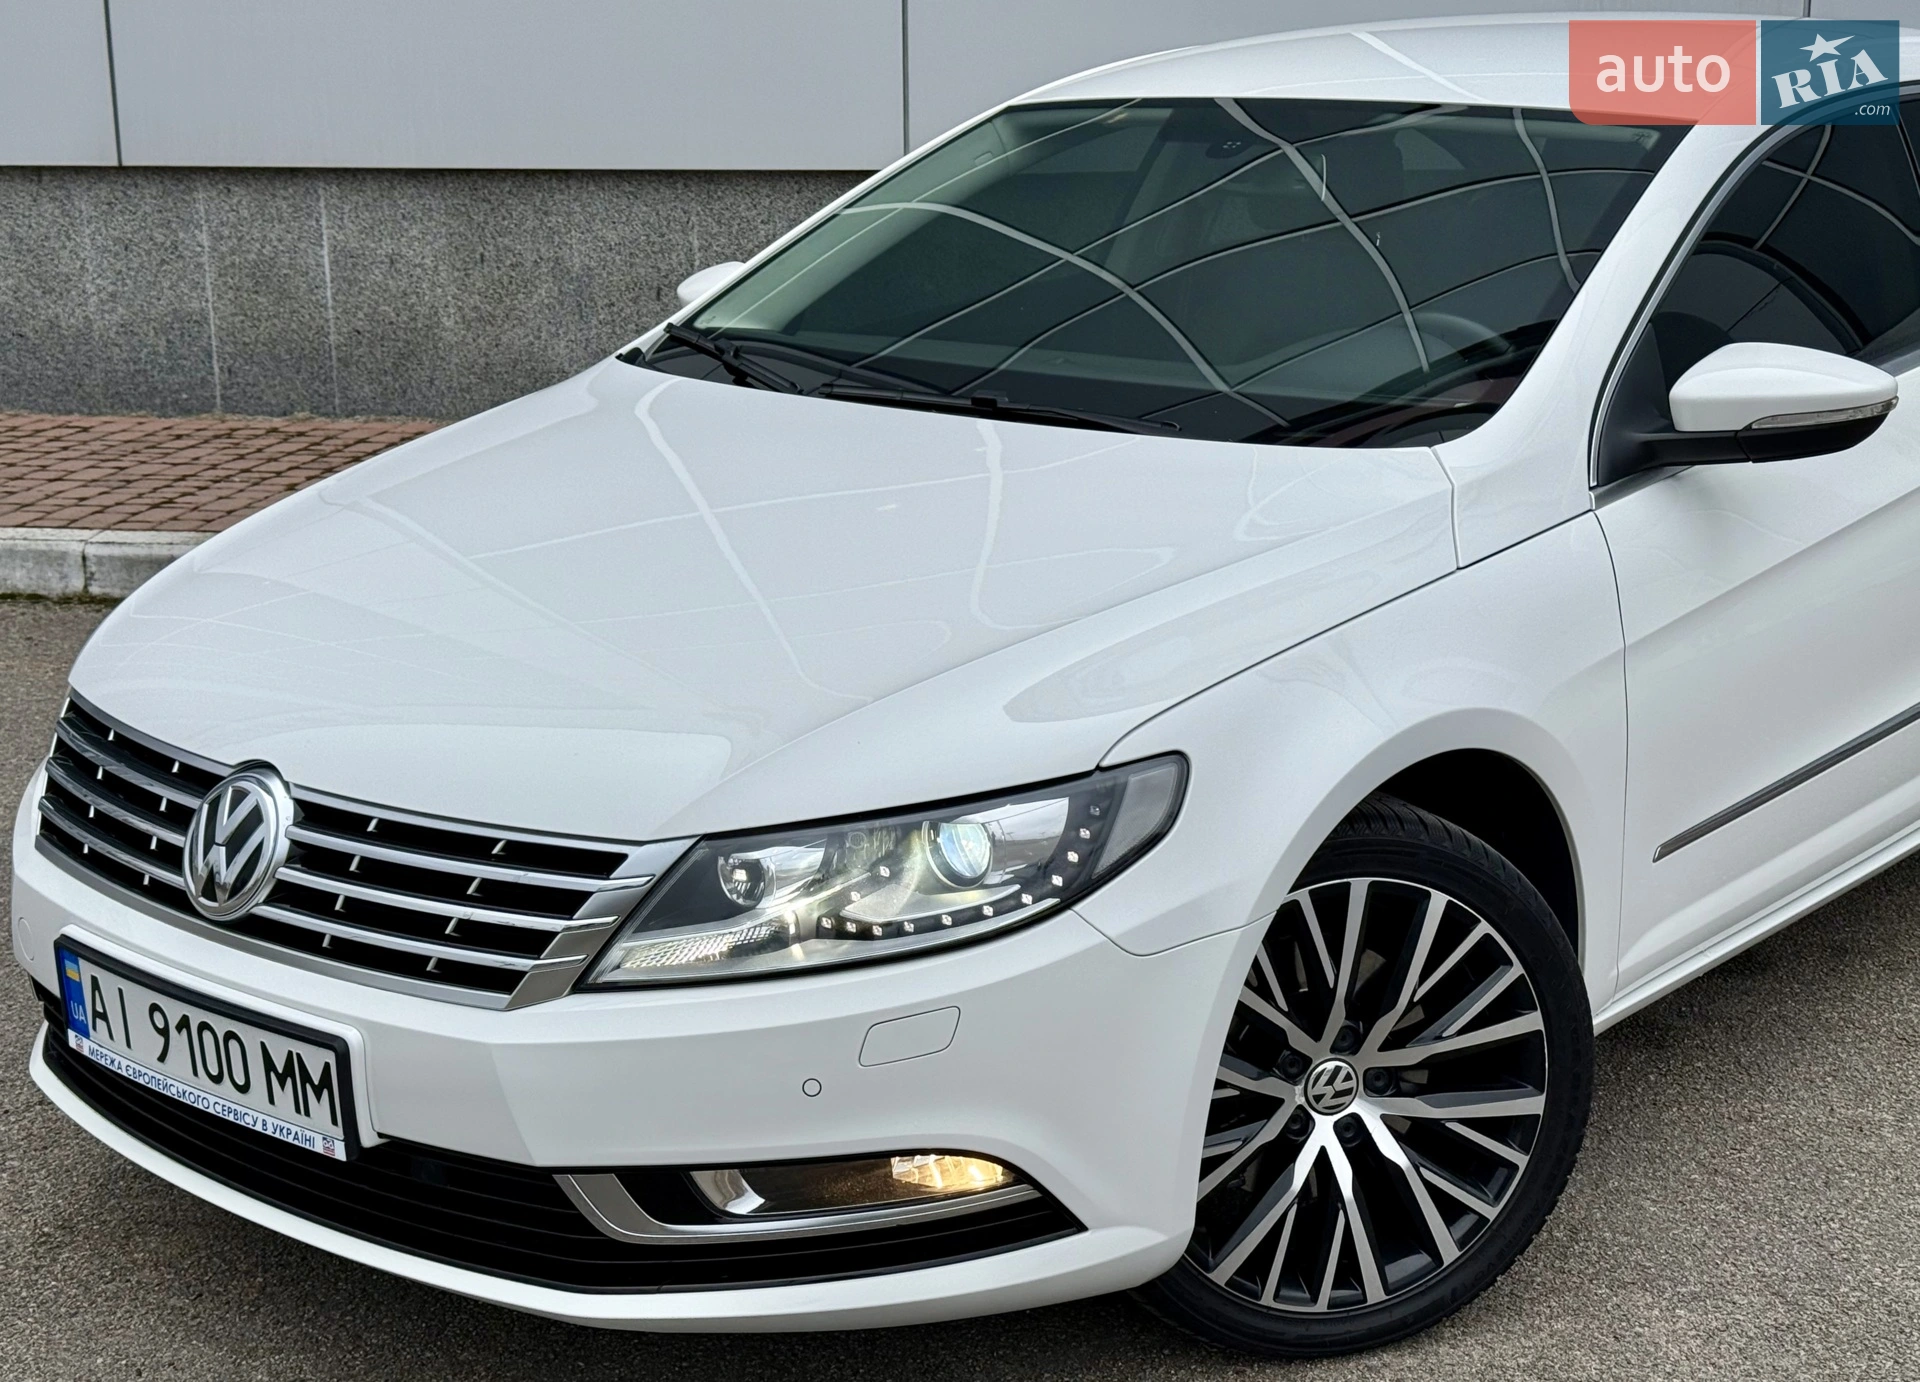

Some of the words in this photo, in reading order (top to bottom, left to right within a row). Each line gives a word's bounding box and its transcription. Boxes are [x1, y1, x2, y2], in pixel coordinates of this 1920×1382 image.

[70, 1001, 87, 1025] UA
[90, 974, 133, 1050] AI
[148, 1002, 252, 1095] 9100
[260, 1040, 340, 1127] MM
[88, 1044, 124, 1074] МЕРЕЖА
[125, 1062, 211, 1110] ЄВРОПЕЙСЬКОГО
[212, 1100, 260, 1129] СЕРВІСУ
[261, 1117, 269, 1133] В
[270, 1121, 317, 1150] УКРАЇНІ
